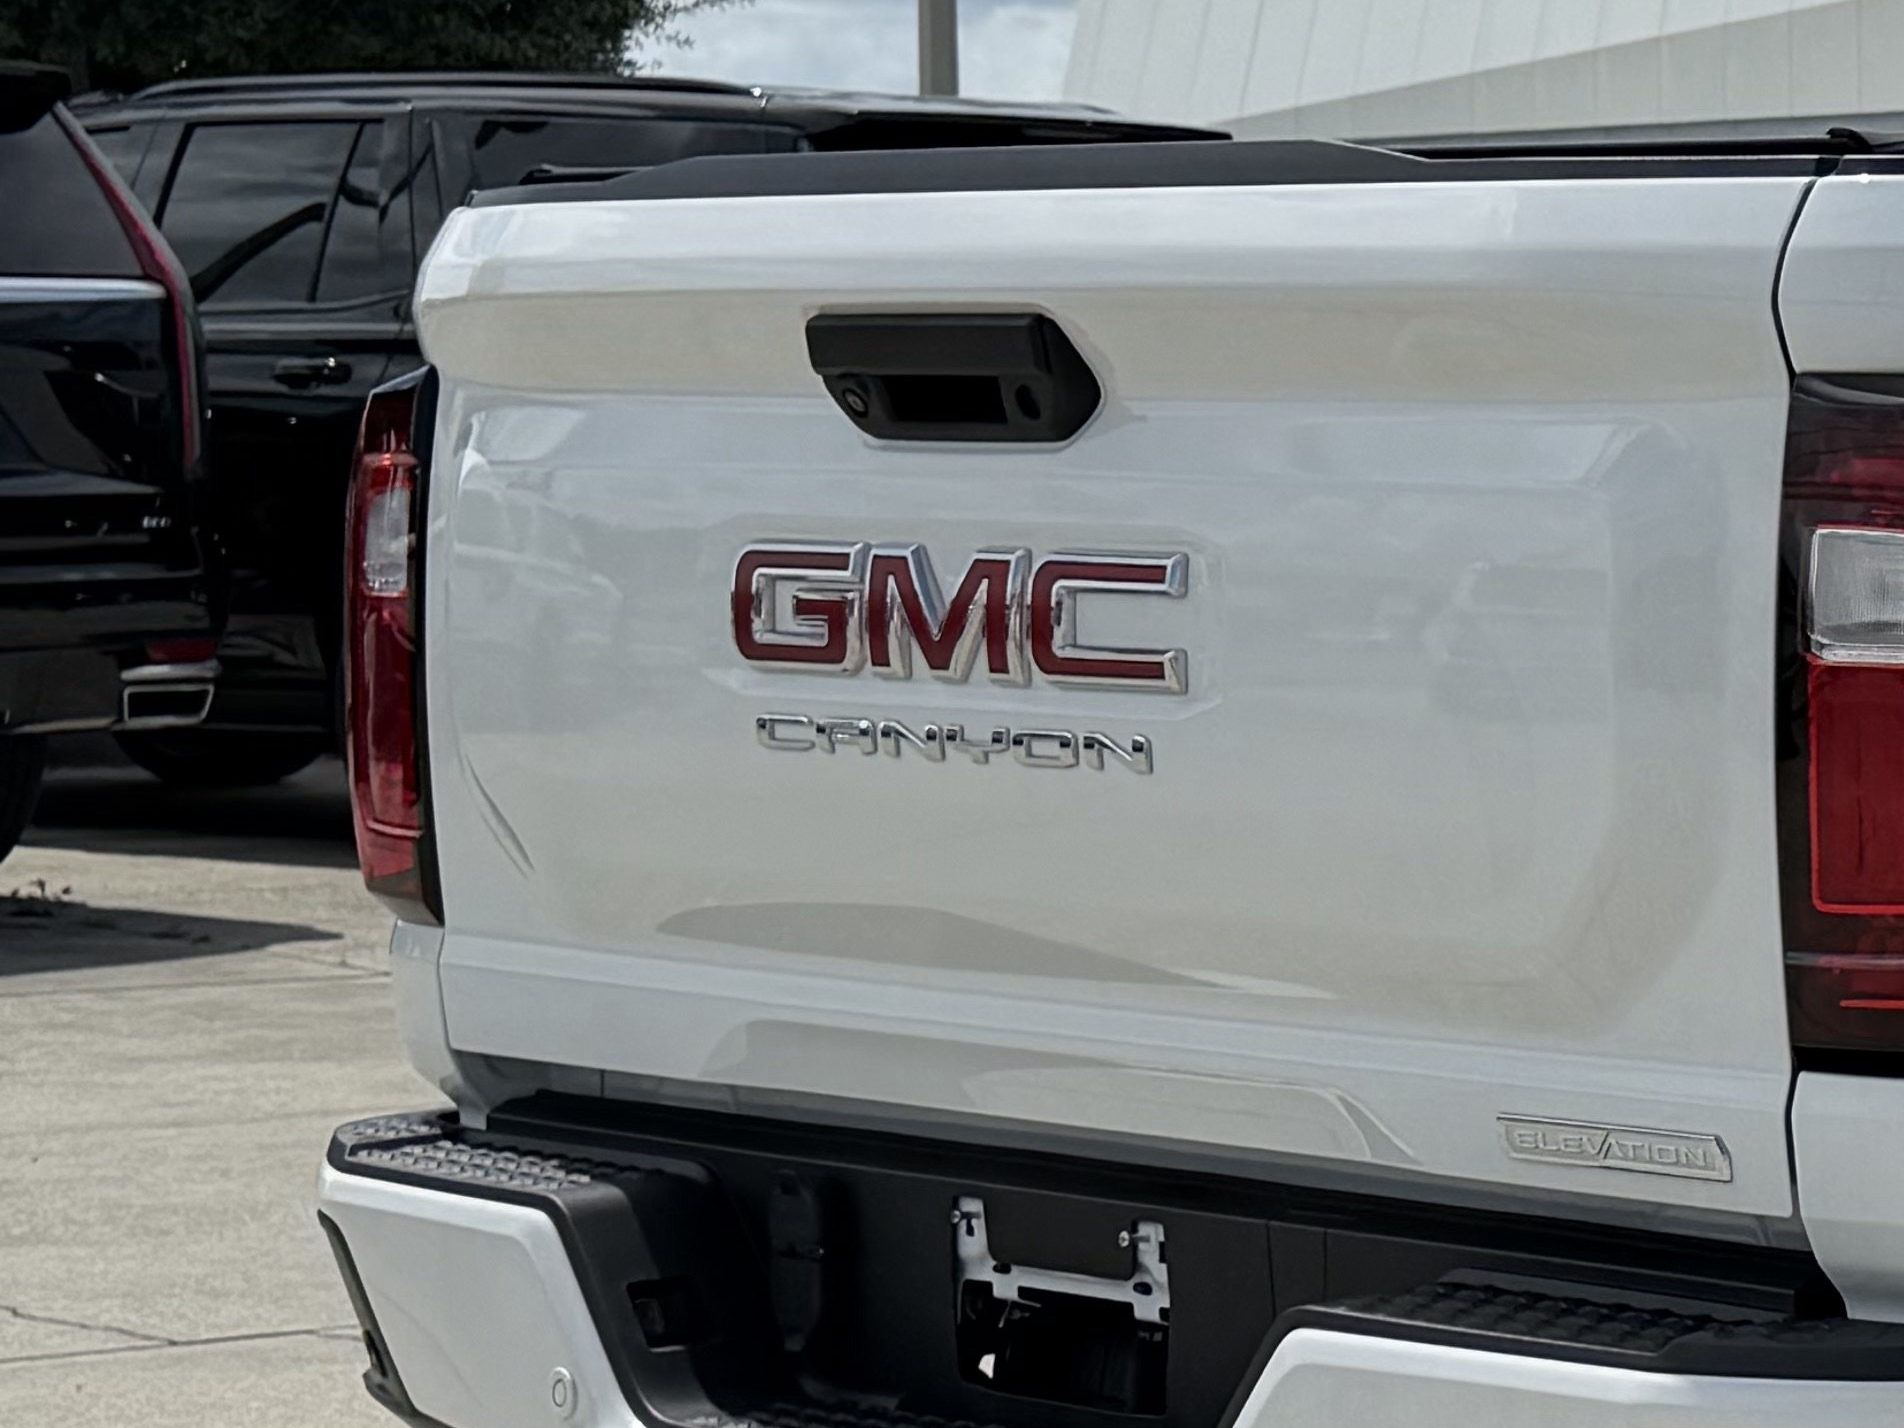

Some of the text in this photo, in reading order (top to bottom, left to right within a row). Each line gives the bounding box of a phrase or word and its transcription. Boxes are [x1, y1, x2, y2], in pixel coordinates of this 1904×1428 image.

[730, 537, 1190, 696] GMC
[755, 711, 1155, 776] CANYON
[1512, 1129, 1710, 1167] ELEVATION
